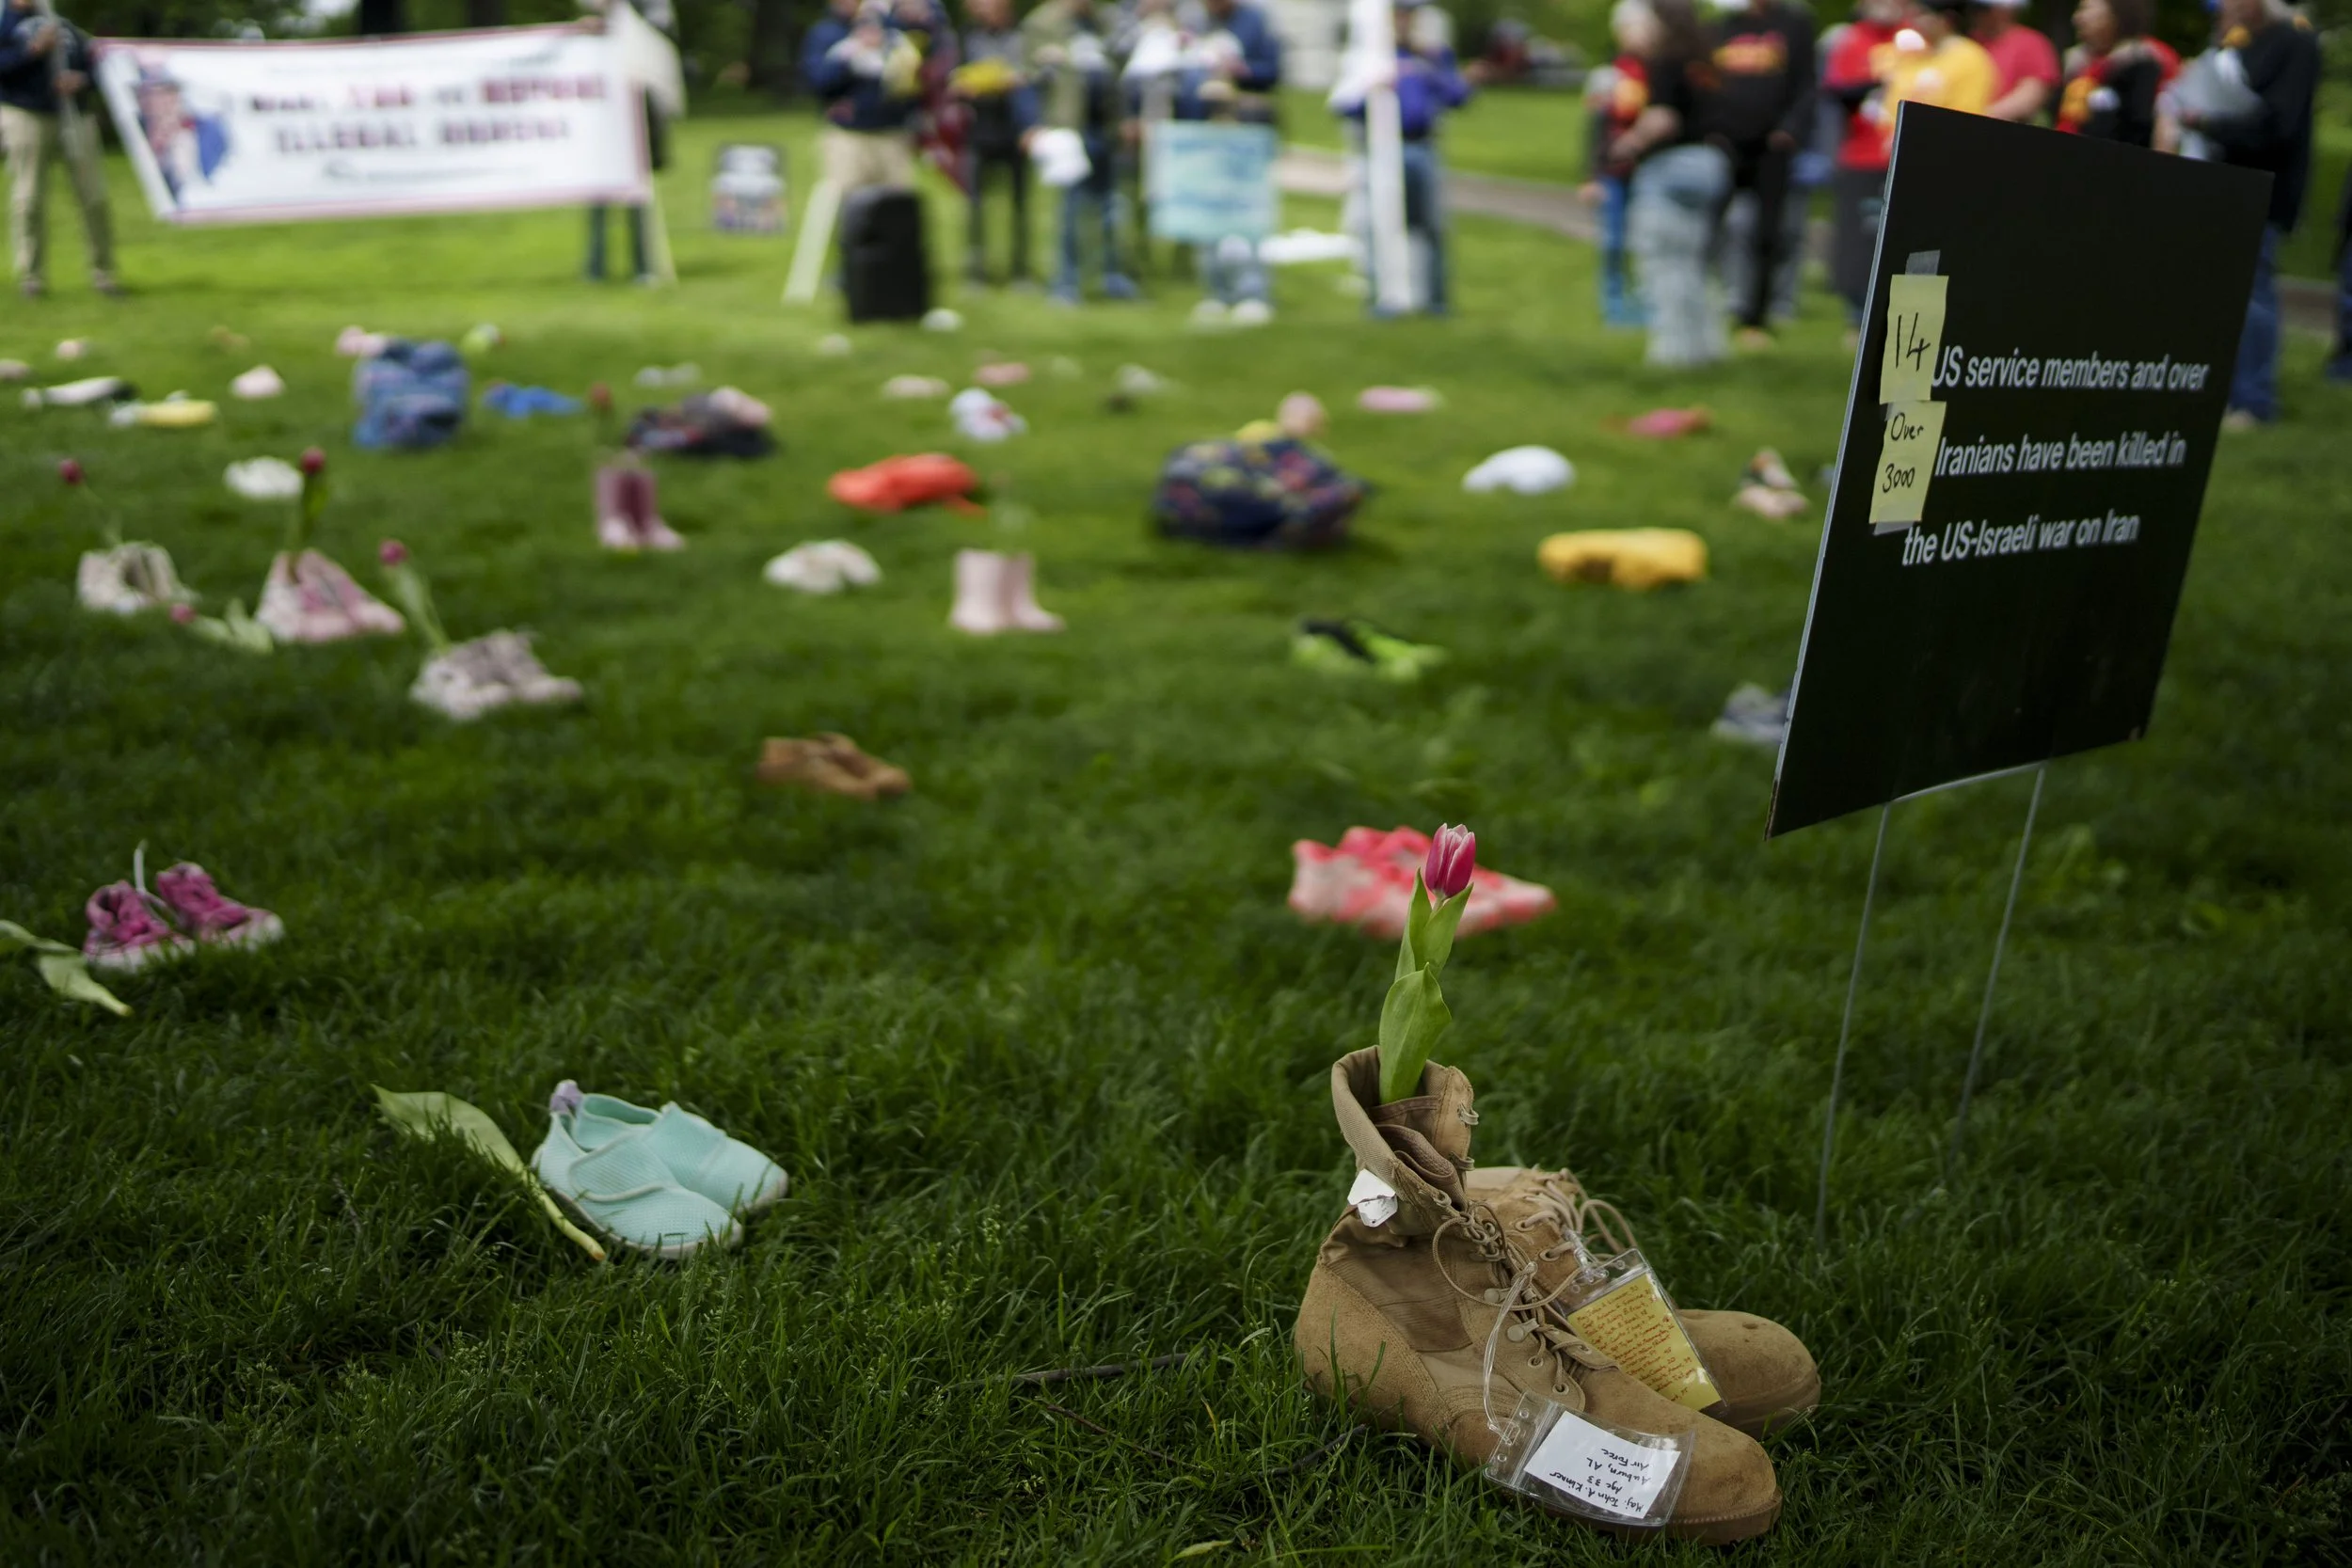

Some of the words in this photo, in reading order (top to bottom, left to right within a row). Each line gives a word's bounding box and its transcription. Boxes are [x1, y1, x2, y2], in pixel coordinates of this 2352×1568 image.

[1895, 312, 1931, 372] 14
[1931, 344, 1964, 388] US
[1964, 346, 2040, 388] service
[2040, 350, 2130, 388] members
[2131, 353, 2170, 390] and
[2168, 363, 2210, 390] over
[1890, 412, 1924, 441] Over
[1934, 434, 2016, 477] Iranians
[2016, 433, 2065, 471] have
[2065, 431, 2116, 469] been
[2115, 430, 2170, 467] killed
[2166, 430, 2187, 467] in
[1882, 463, 1915, 494] 3000
[1901, 526, 1938, 566] the
[1940, 514, 2040, 562] US-Israeli
[2038, 519, 2077, 550] war
[2075, 517, 2104, 547] on
[2102, 508, 2141, 543] Iran
[1585, 1457, 1603, 1471] AL
[1600, 1448, 1629, 1467] Force
[1630, 1462, 1650, 1471] Air
[1587, 1475, 1601, 1487] 33
[1607, 1463, 1652, 1485] Auburn,
[1585, 1486, 1597, 1498] A.
[1603, 1481, 1624, 1495] Age
[1598, 1491, 1619, 1507] John
[1624, 1497, 1645, 1513] Maj.
